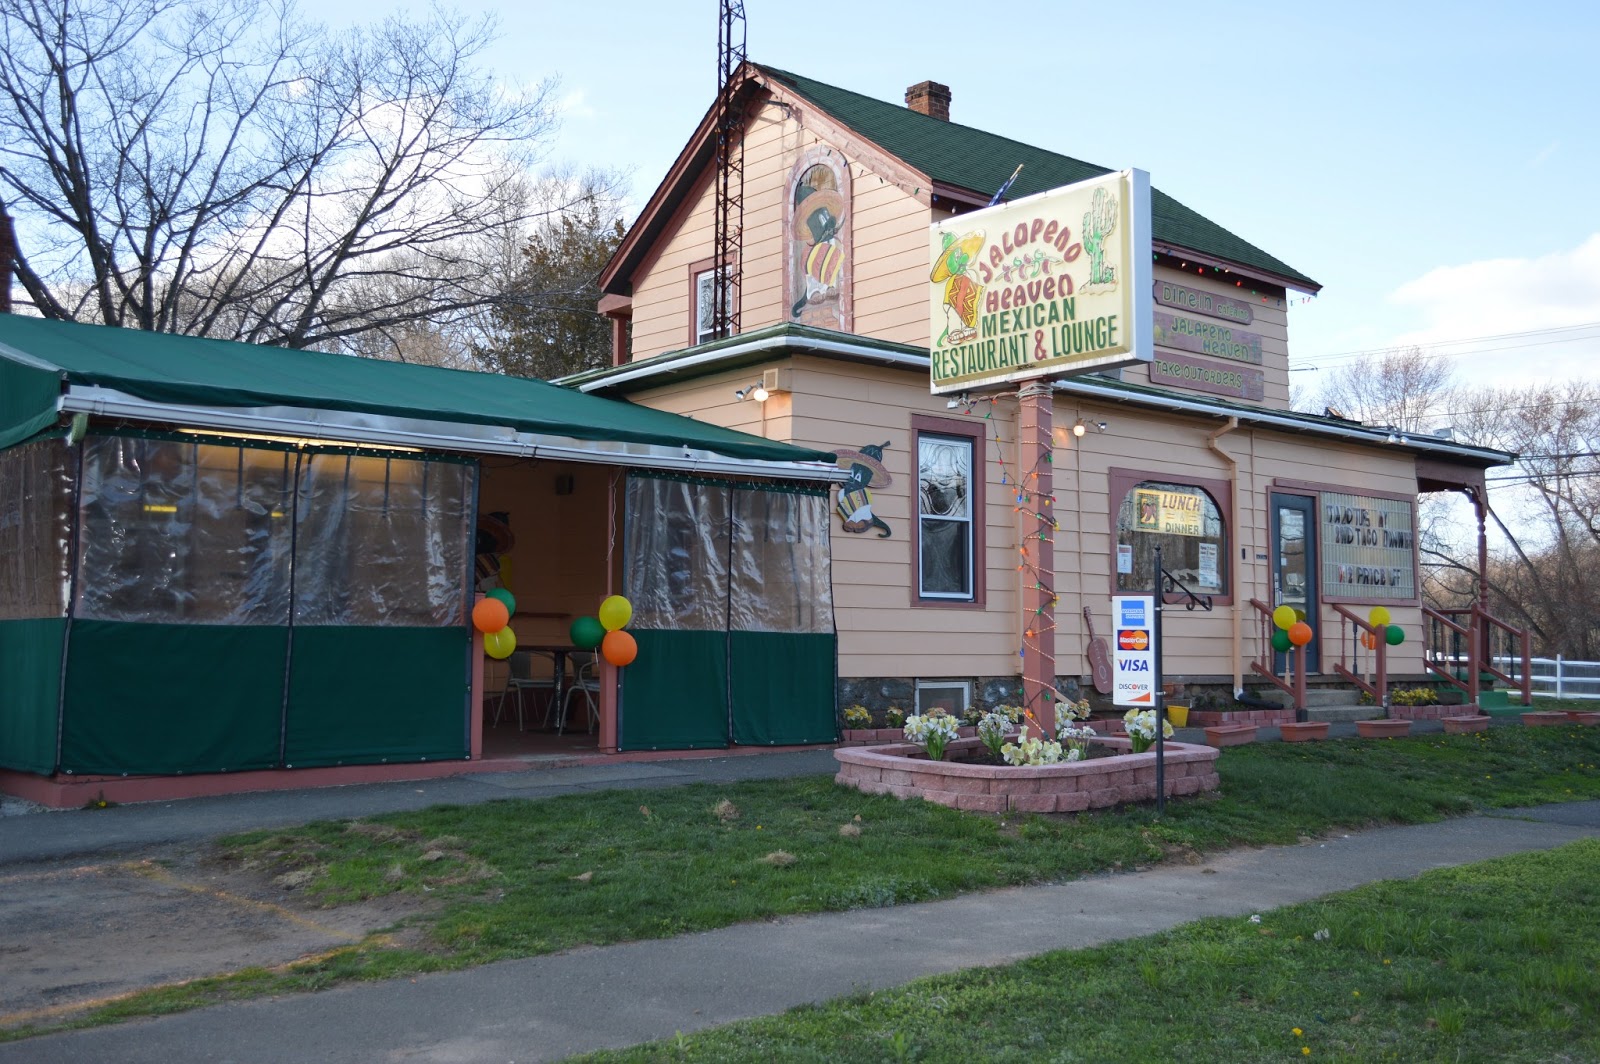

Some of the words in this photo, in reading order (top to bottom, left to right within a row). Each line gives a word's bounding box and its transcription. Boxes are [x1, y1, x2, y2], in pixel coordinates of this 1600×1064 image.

[981, 296, 1076, 339] MEXICAN
[932, 333, 1029, 381] RESTAURANT
[1034, 329, 1047, 361] &
[1051, 315, 1118, 358] LOUNGE
[1162, 494, 1202, 512] LUNCH
[1165, 522, 1199, 535] DINNER
[1118, 659, 1149, 671] VISA
[1118, 683, 1149, 691] DISCOVER
